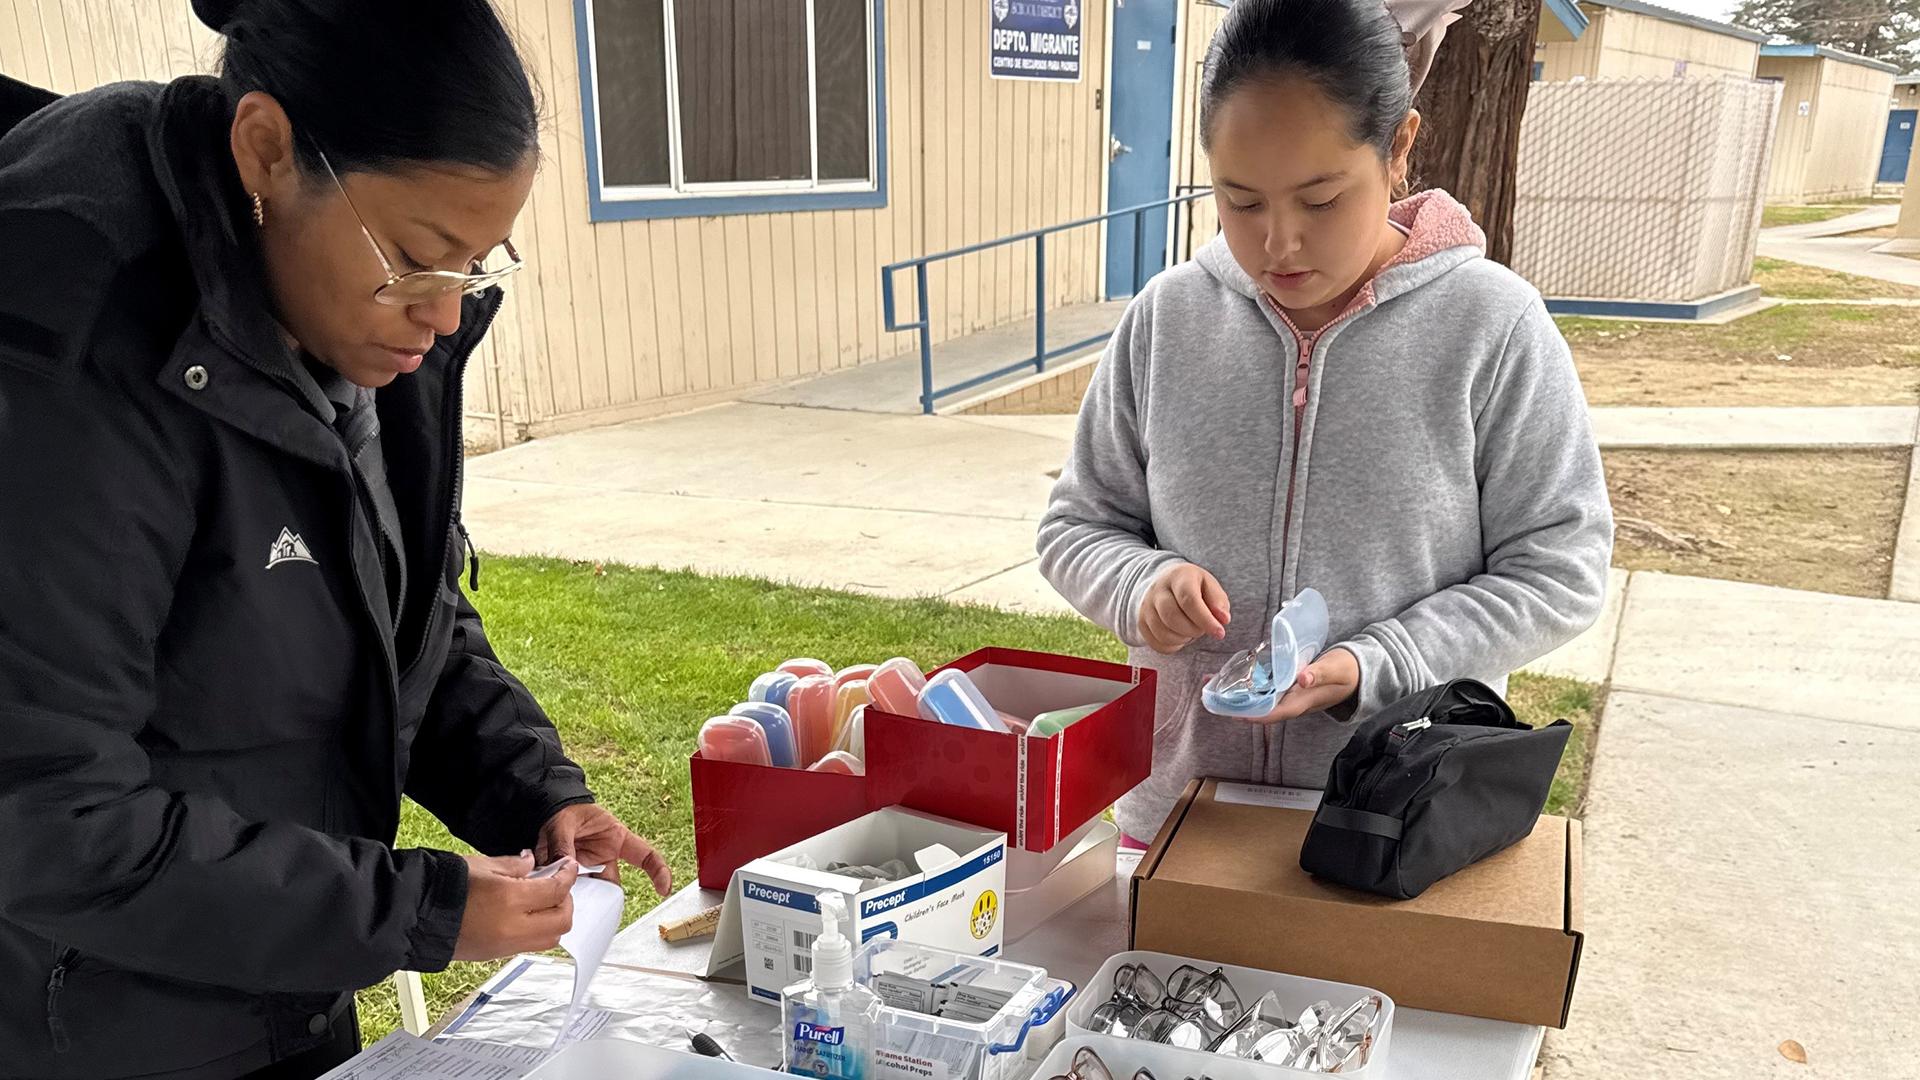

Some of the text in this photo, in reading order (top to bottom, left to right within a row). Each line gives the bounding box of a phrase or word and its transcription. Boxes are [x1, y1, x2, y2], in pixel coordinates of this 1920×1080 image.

[993, 28, 1079, 56] DEPTO. MIGRANTE
[983, 850, 1001, 865] 15150
[748, 883, 790, 904] Precept
[865, 890, 906, 914] Precept
[904, 904, 935, 922] Children's
[800, 1023, 840, 1045] Purell
[903, 1056, 933, 1068] Station
[909, 1065, 933, 1076] Preps
